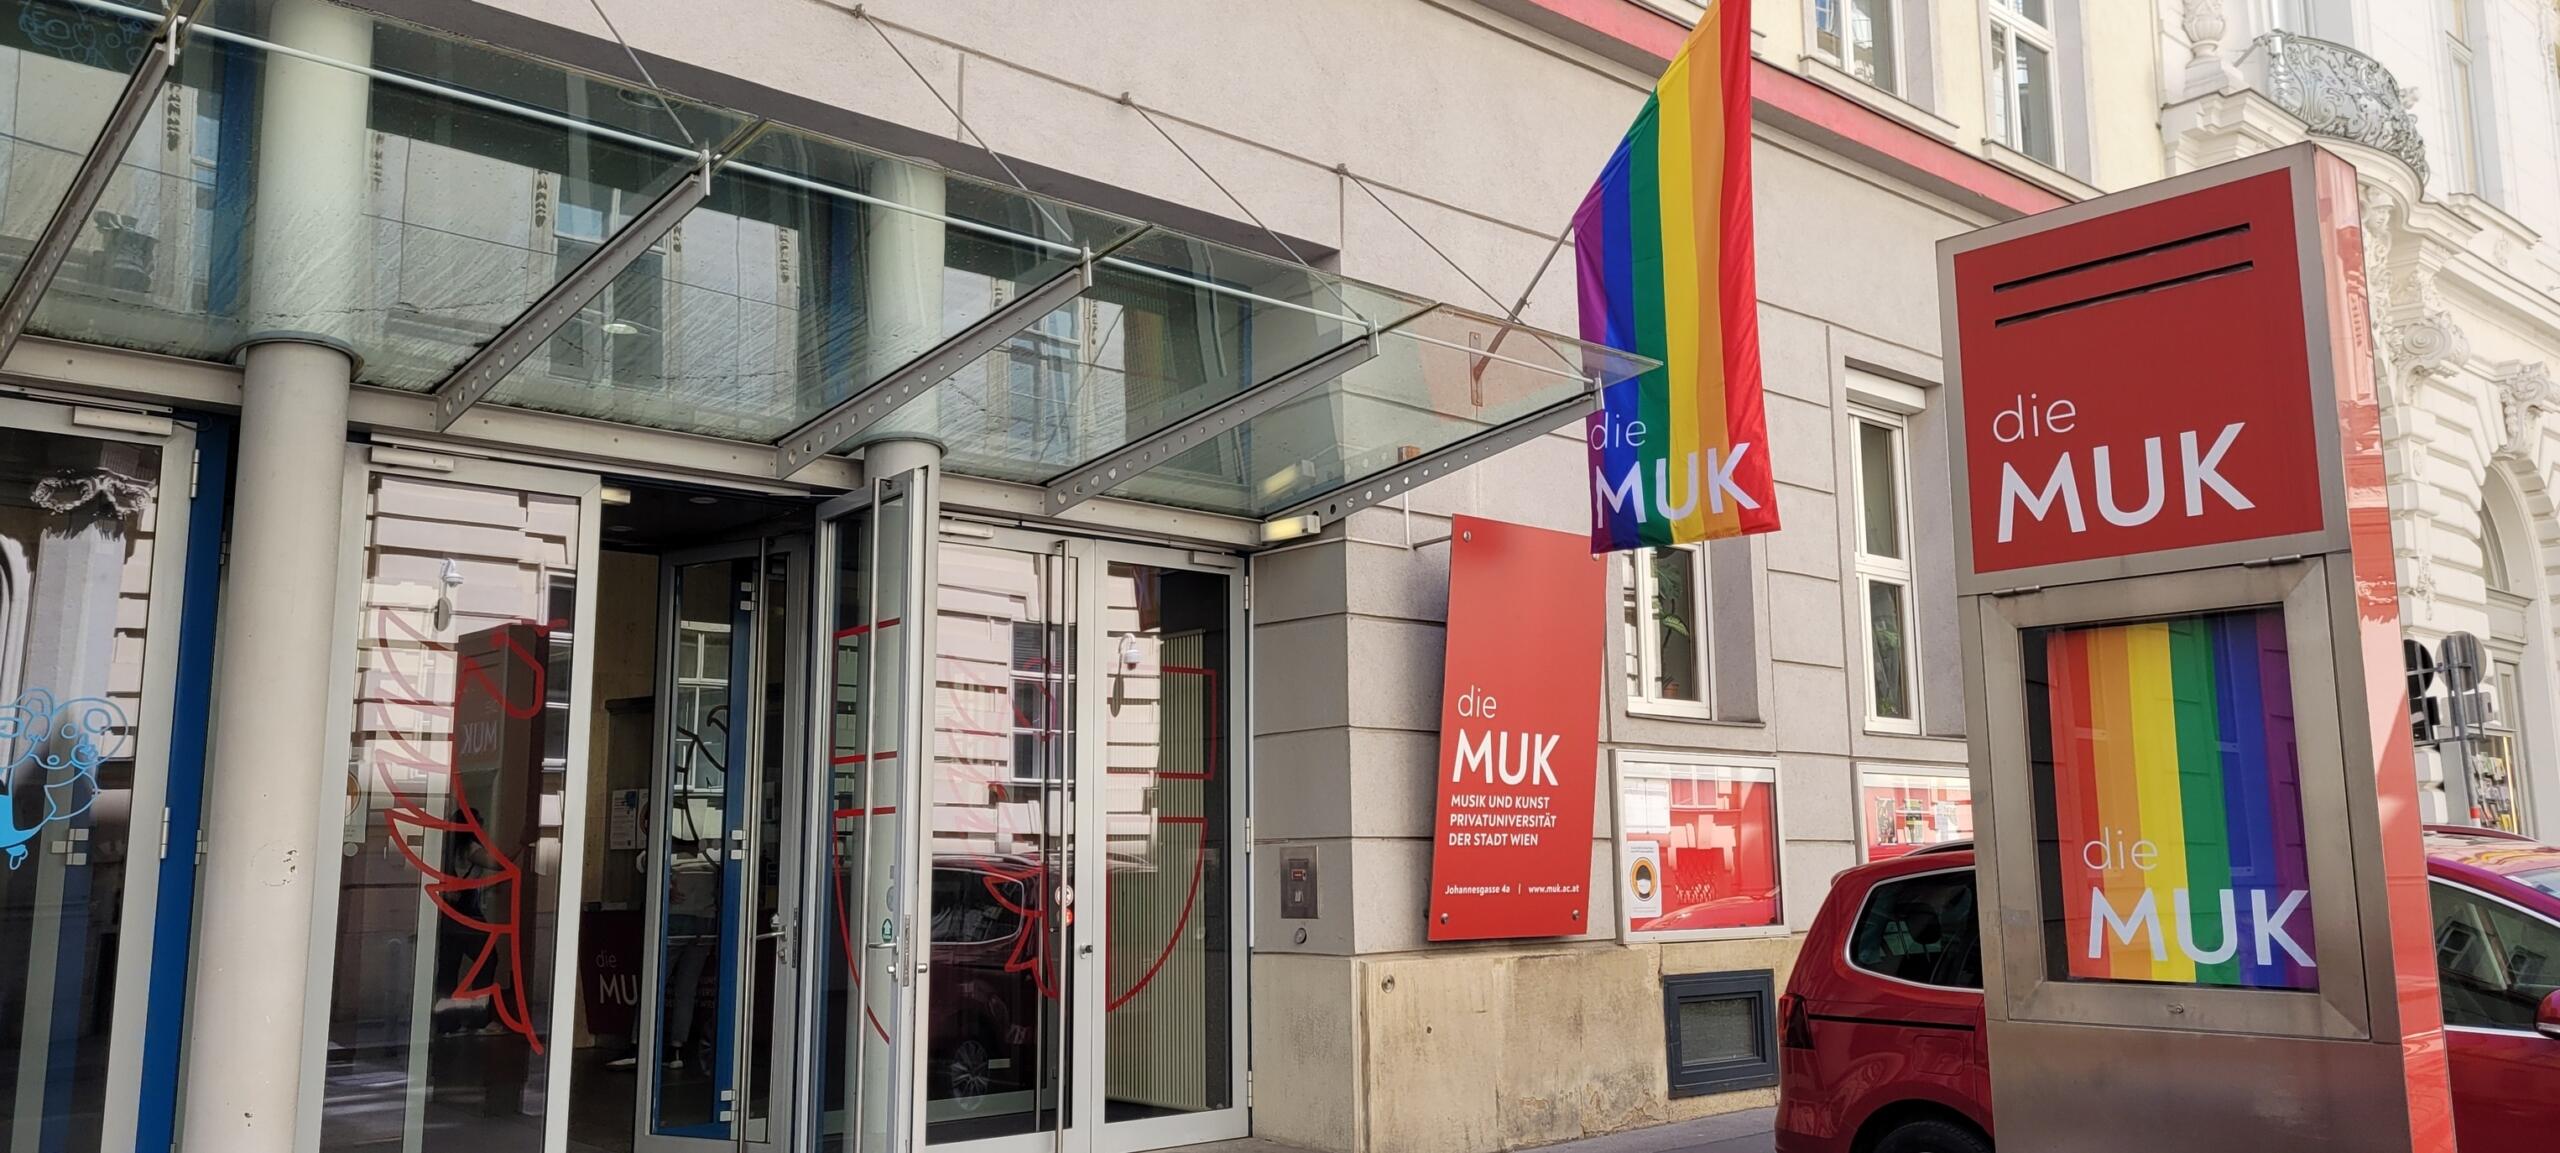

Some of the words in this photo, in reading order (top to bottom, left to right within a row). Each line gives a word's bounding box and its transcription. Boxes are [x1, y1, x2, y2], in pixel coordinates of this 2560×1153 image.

[1590, 411, 1647, 450] die
[1993, 393, 2077, 444] die
[1595, 441, 1761, 529] MUK
[1997, 422, 2257, 543] MUK
[1457, 684, 1497, 719] die
[1452, 727, 1561, 787] MUK
[1449, 812, 1557, 828] PRIVATUNIVERSITÄT
[1450, 794, 1486, 808] MUSIK
[1488, 795, 1513, 808] UND
[1515, 796, 1551, 809] KUNST
[1448, 832, 1471, 846] DER
[1473, 833, 1508, 846] STADT
[1510, 833, 1539, 846] WIEN
[2083, 826, 2158, 871] die
[1444, 884, 1500, 896] Johannesgasse
[1501, 884, 1511, 894] 4a
[1528, 883, 1580, 894] www.muk.ac.at
[2088, 886, 2318, 968] MUK
[596, 949, 617, 968] die
[599, 973, 638, 1006] MU
